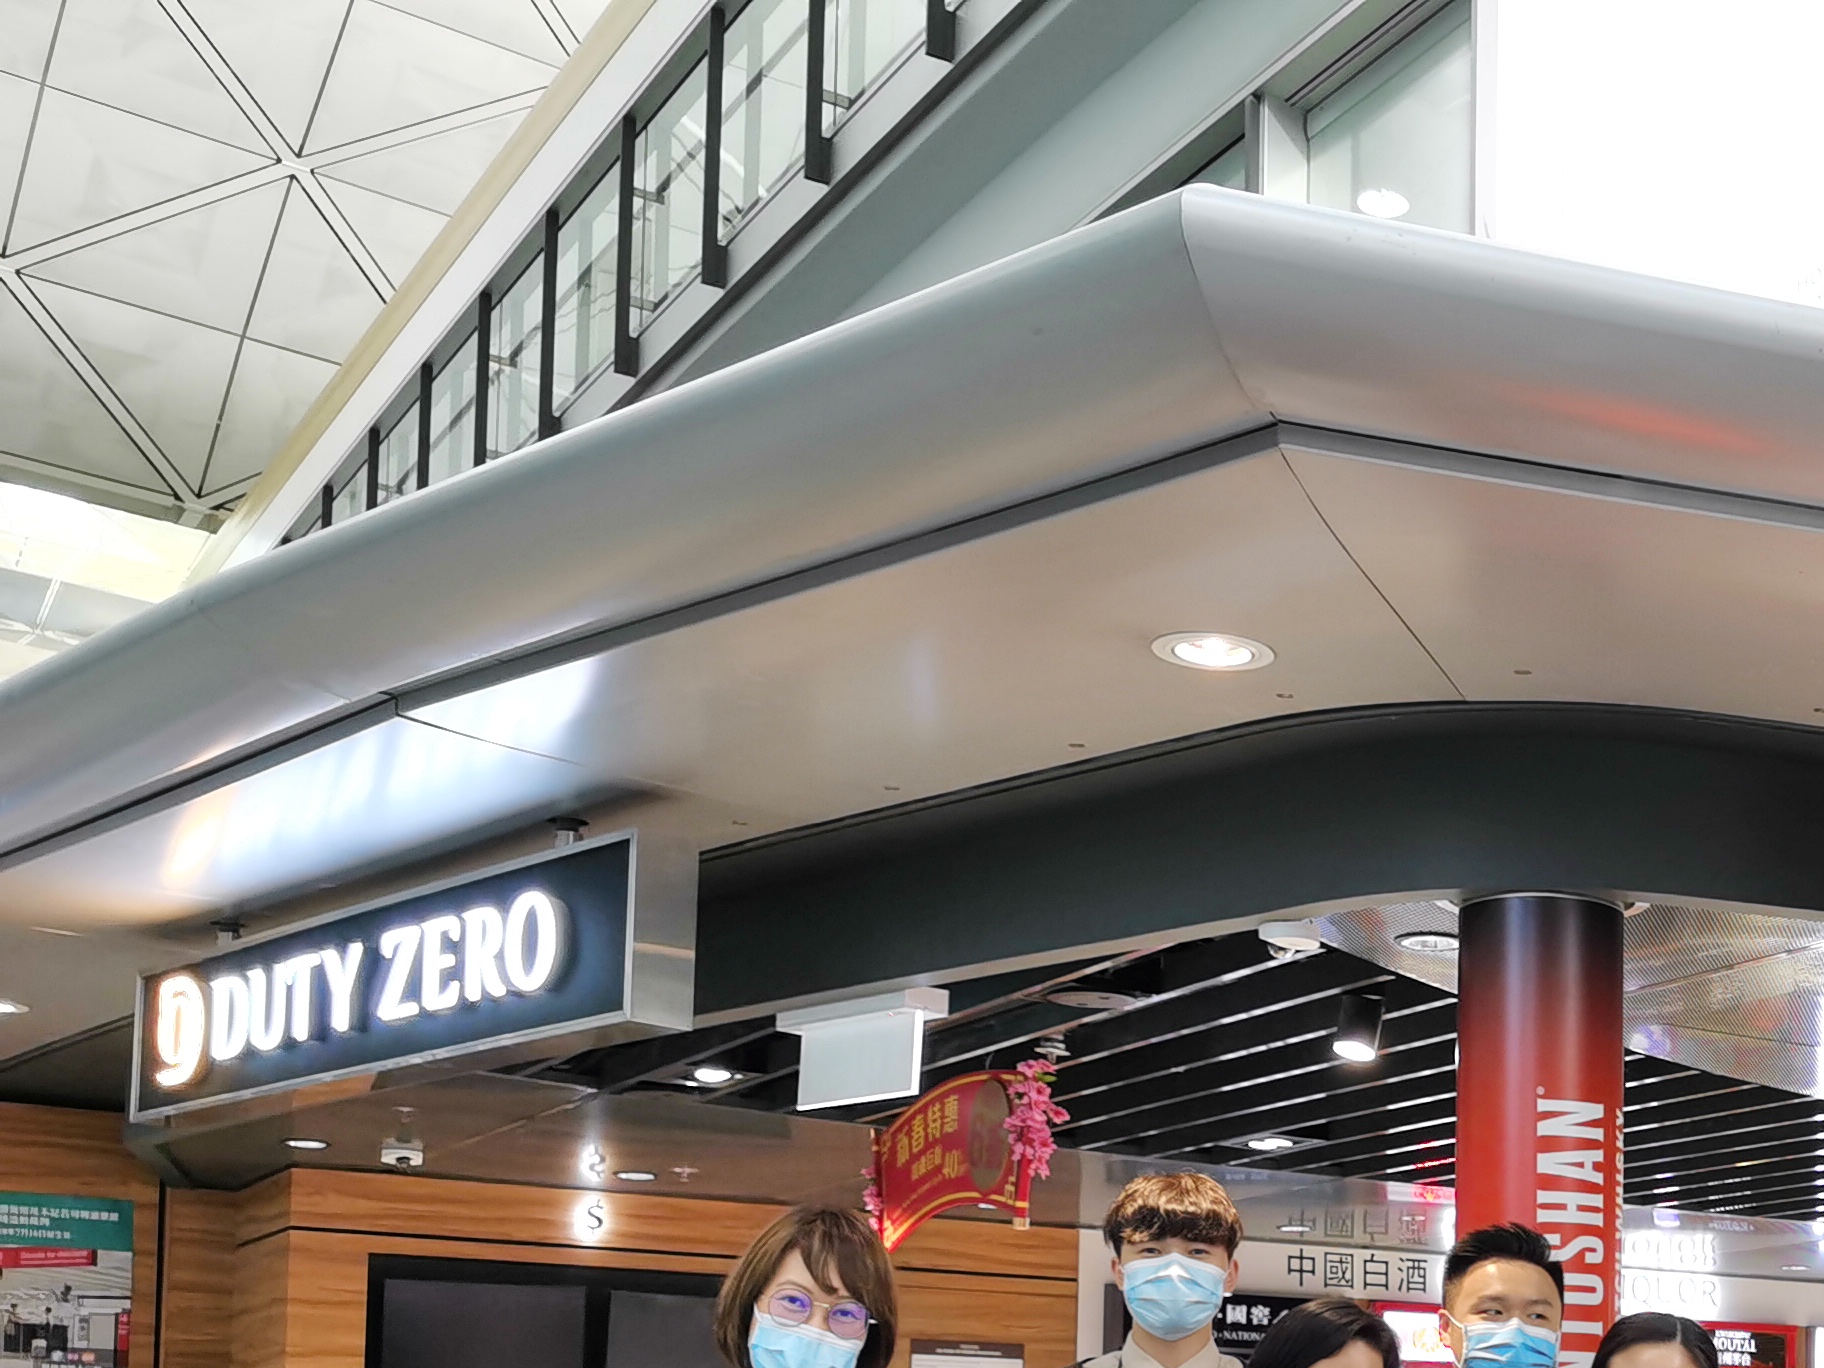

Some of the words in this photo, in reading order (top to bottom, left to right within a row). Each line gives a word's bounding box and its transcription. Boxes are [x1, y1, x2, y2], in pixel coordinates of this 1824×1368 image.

[209, 939, 365, 1062] DUTY
[376, 890, 558, 1023] ZERO
[1287, 1248, 1428, 1293] 中國白酒
